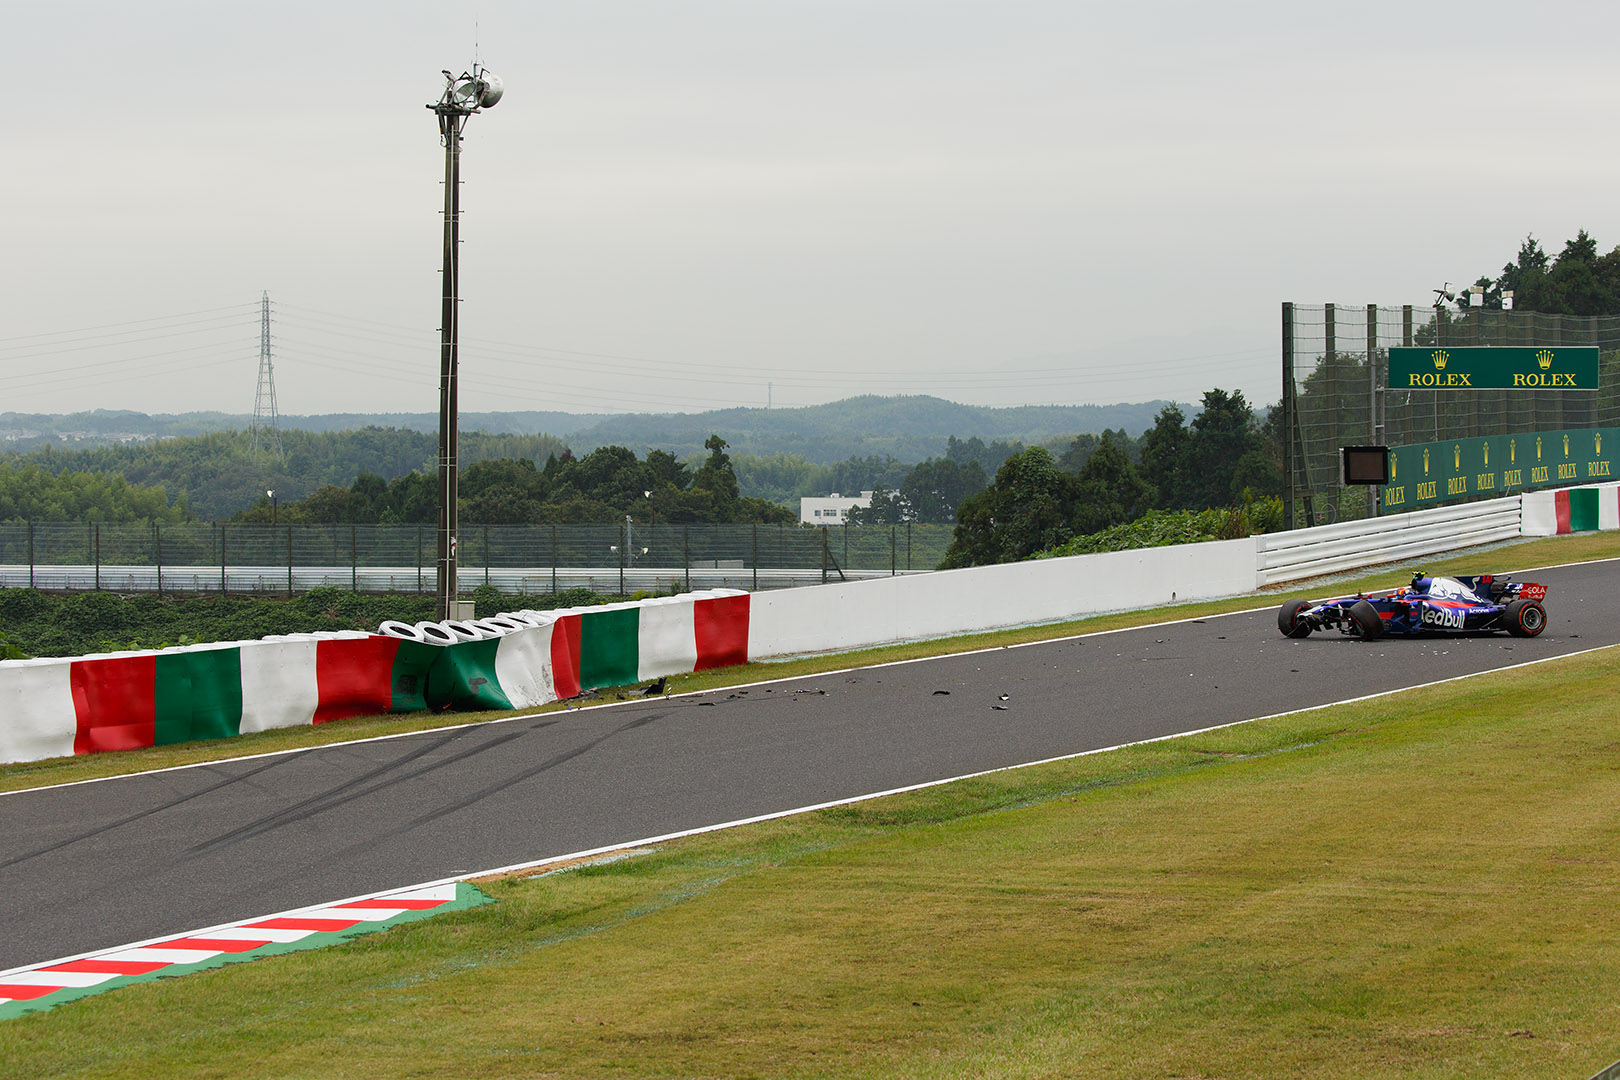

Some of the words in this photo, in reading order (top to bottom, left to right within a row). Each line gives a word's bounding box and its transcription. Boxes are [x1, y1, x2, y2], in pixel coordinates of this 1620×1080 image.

[1409, 373, 1472, 386] ROLEX
[1513, 373, 1577, 386] ROLEX
[1531, 466, 1549, 483] ROLEX
[1558, 463, 1577, 479] ROLEX
[1588, 461, 1611, 476] ROLEX
[1448, 476, 1467, 495] ROLEX
[1477, 473, 1495, 491] ROLEX
[1416, 481, 1437, 501] ROLEX
